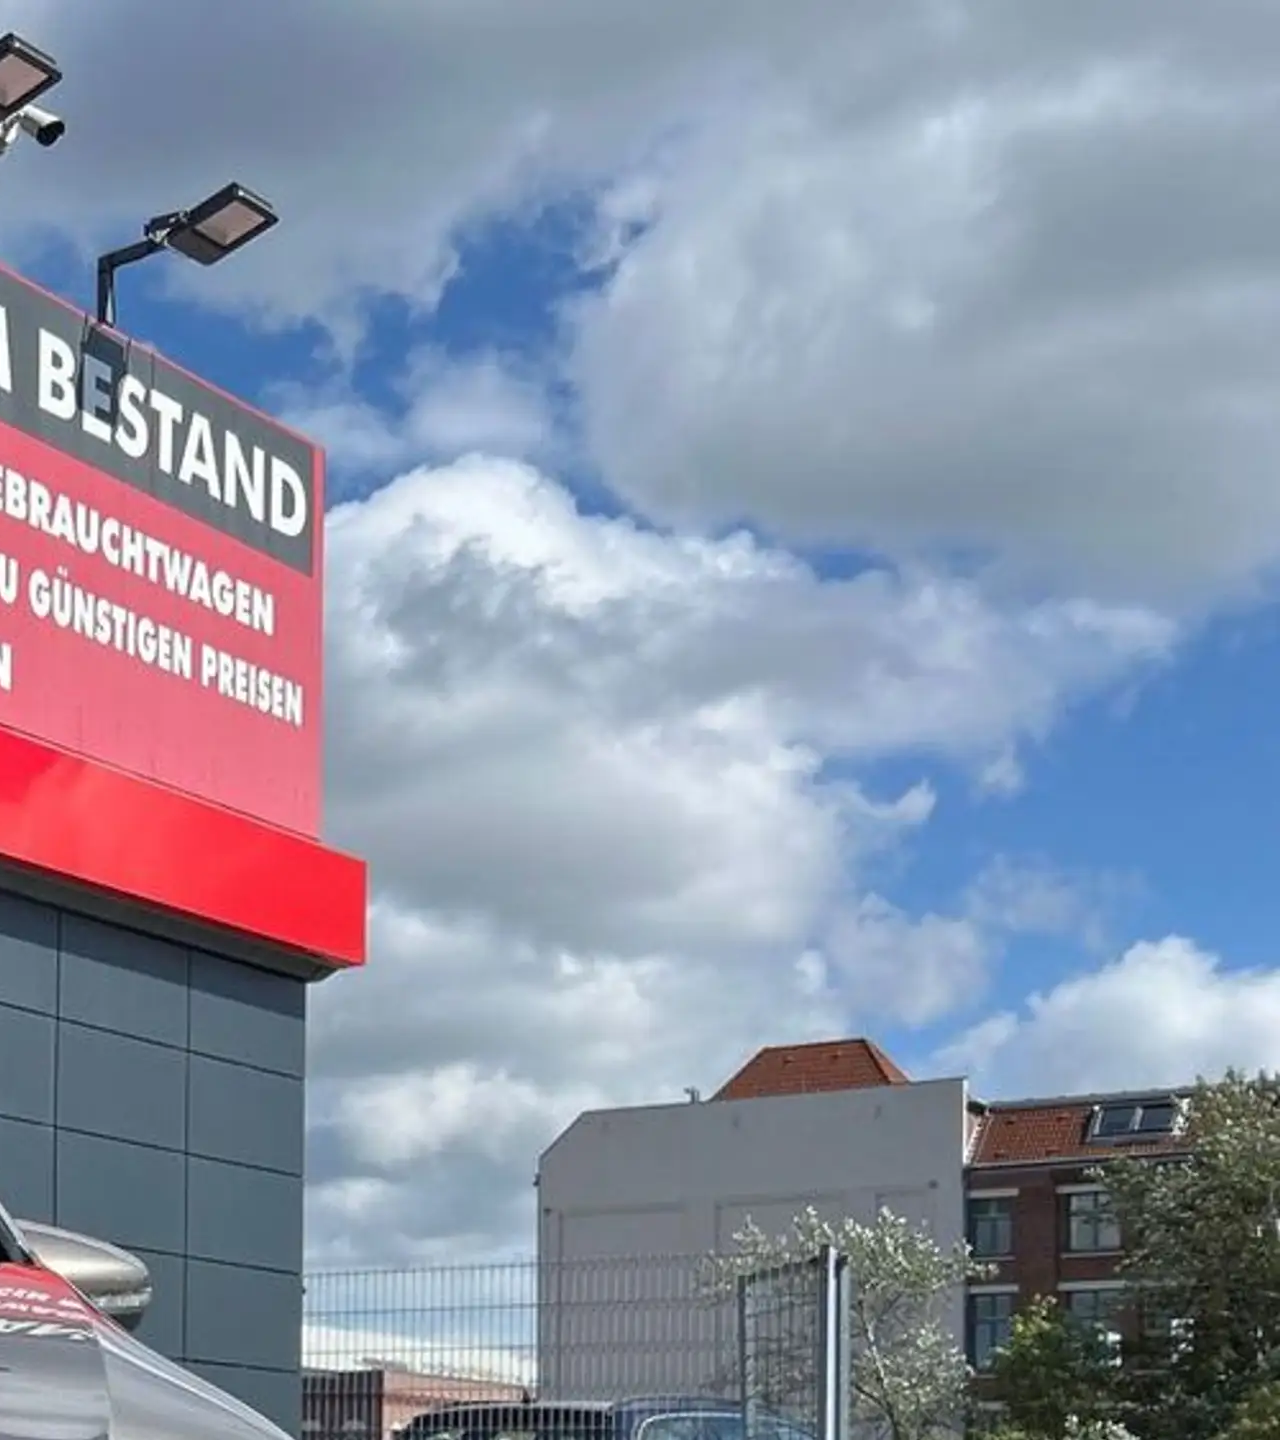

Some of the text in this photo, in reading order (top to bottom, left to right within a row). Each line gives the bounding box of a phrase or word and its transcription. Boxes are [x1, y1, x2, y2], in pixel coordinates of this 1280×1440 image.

[38, 325, 308, 538] BESTAND
[29, 566, 192, 680] GÜNSTIGEN
[201, 649, 303, 726] PREISEN
